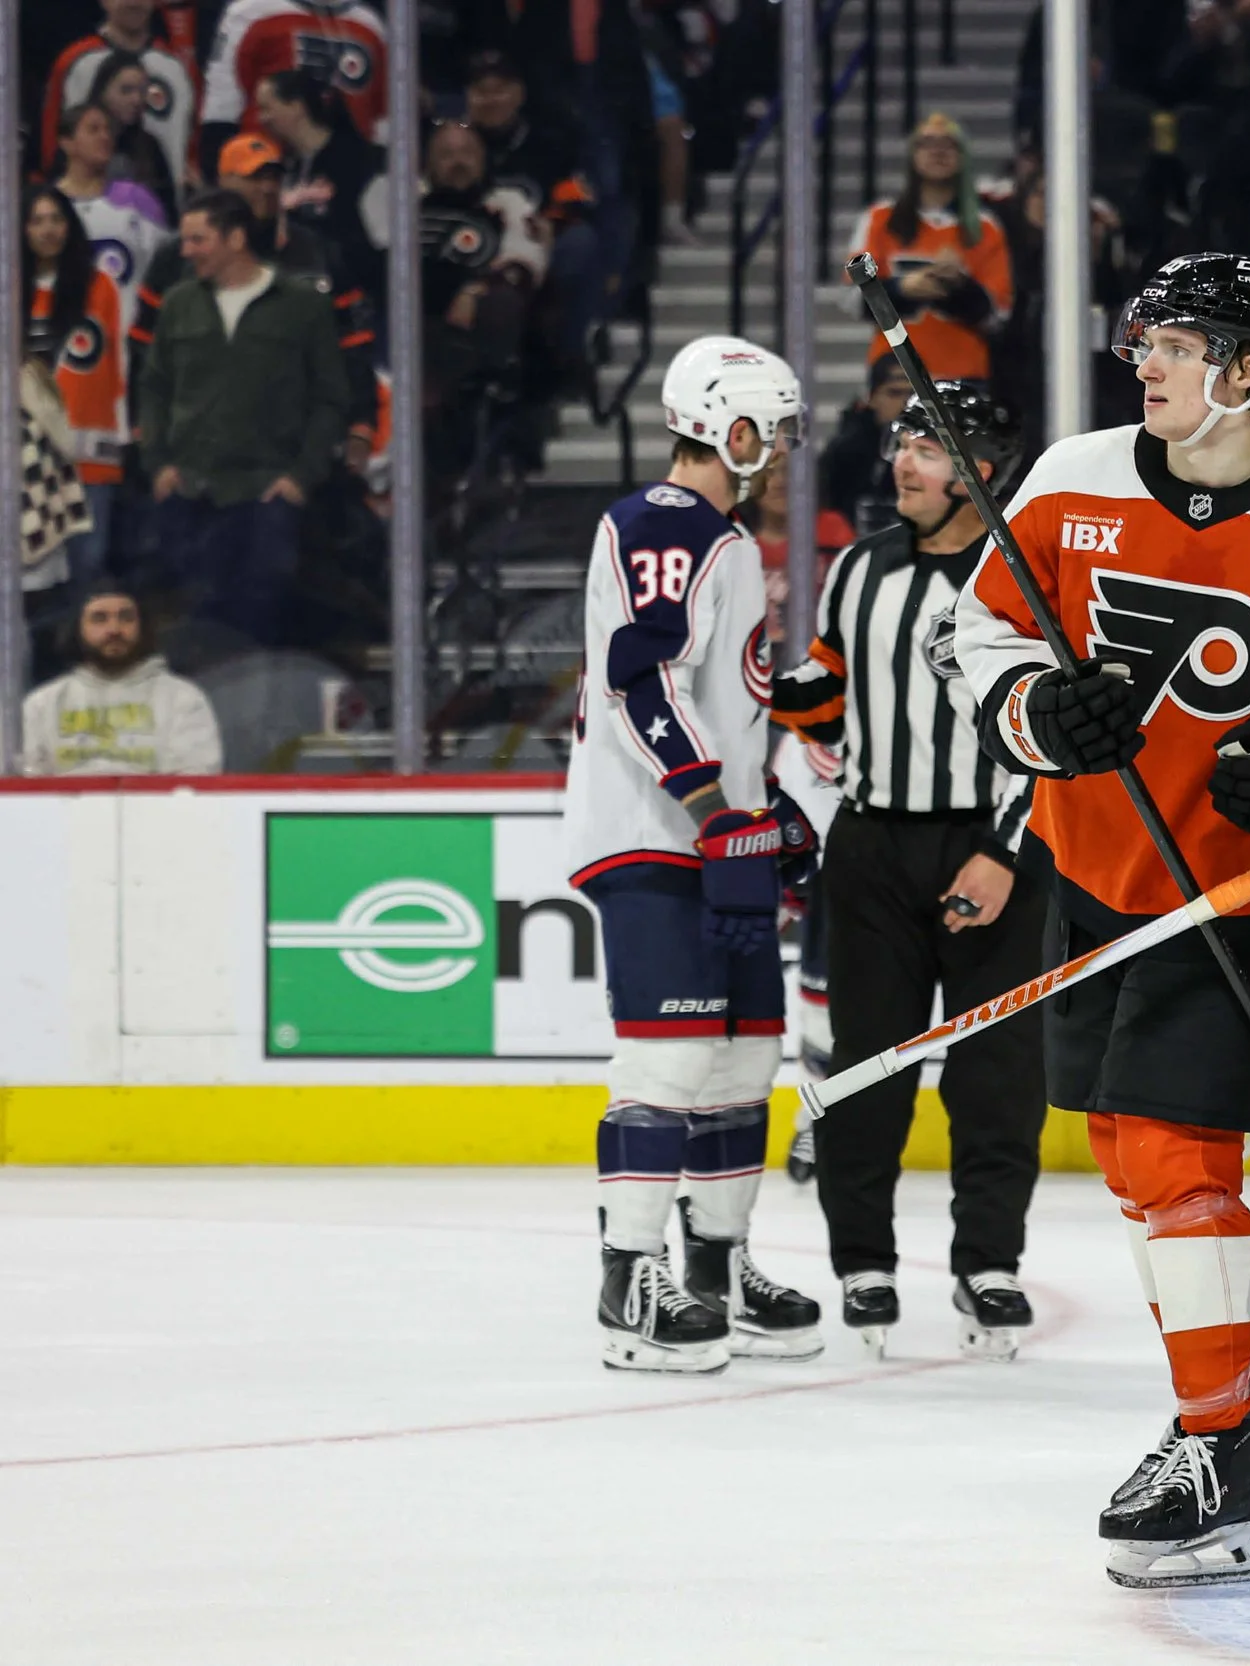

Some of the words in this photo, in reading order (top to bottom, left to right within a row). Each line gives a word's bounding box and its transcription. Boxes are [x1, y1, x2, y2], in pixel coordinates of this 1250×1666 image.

[1142, 287, 1168, 298] CCM
[1063, 512, 1116, 526] Independence
[1061, 521, 1123, 555] IBX
[629, 545, 694, 611] 38
[953, 967, 1066, 1036] FLYLITE
